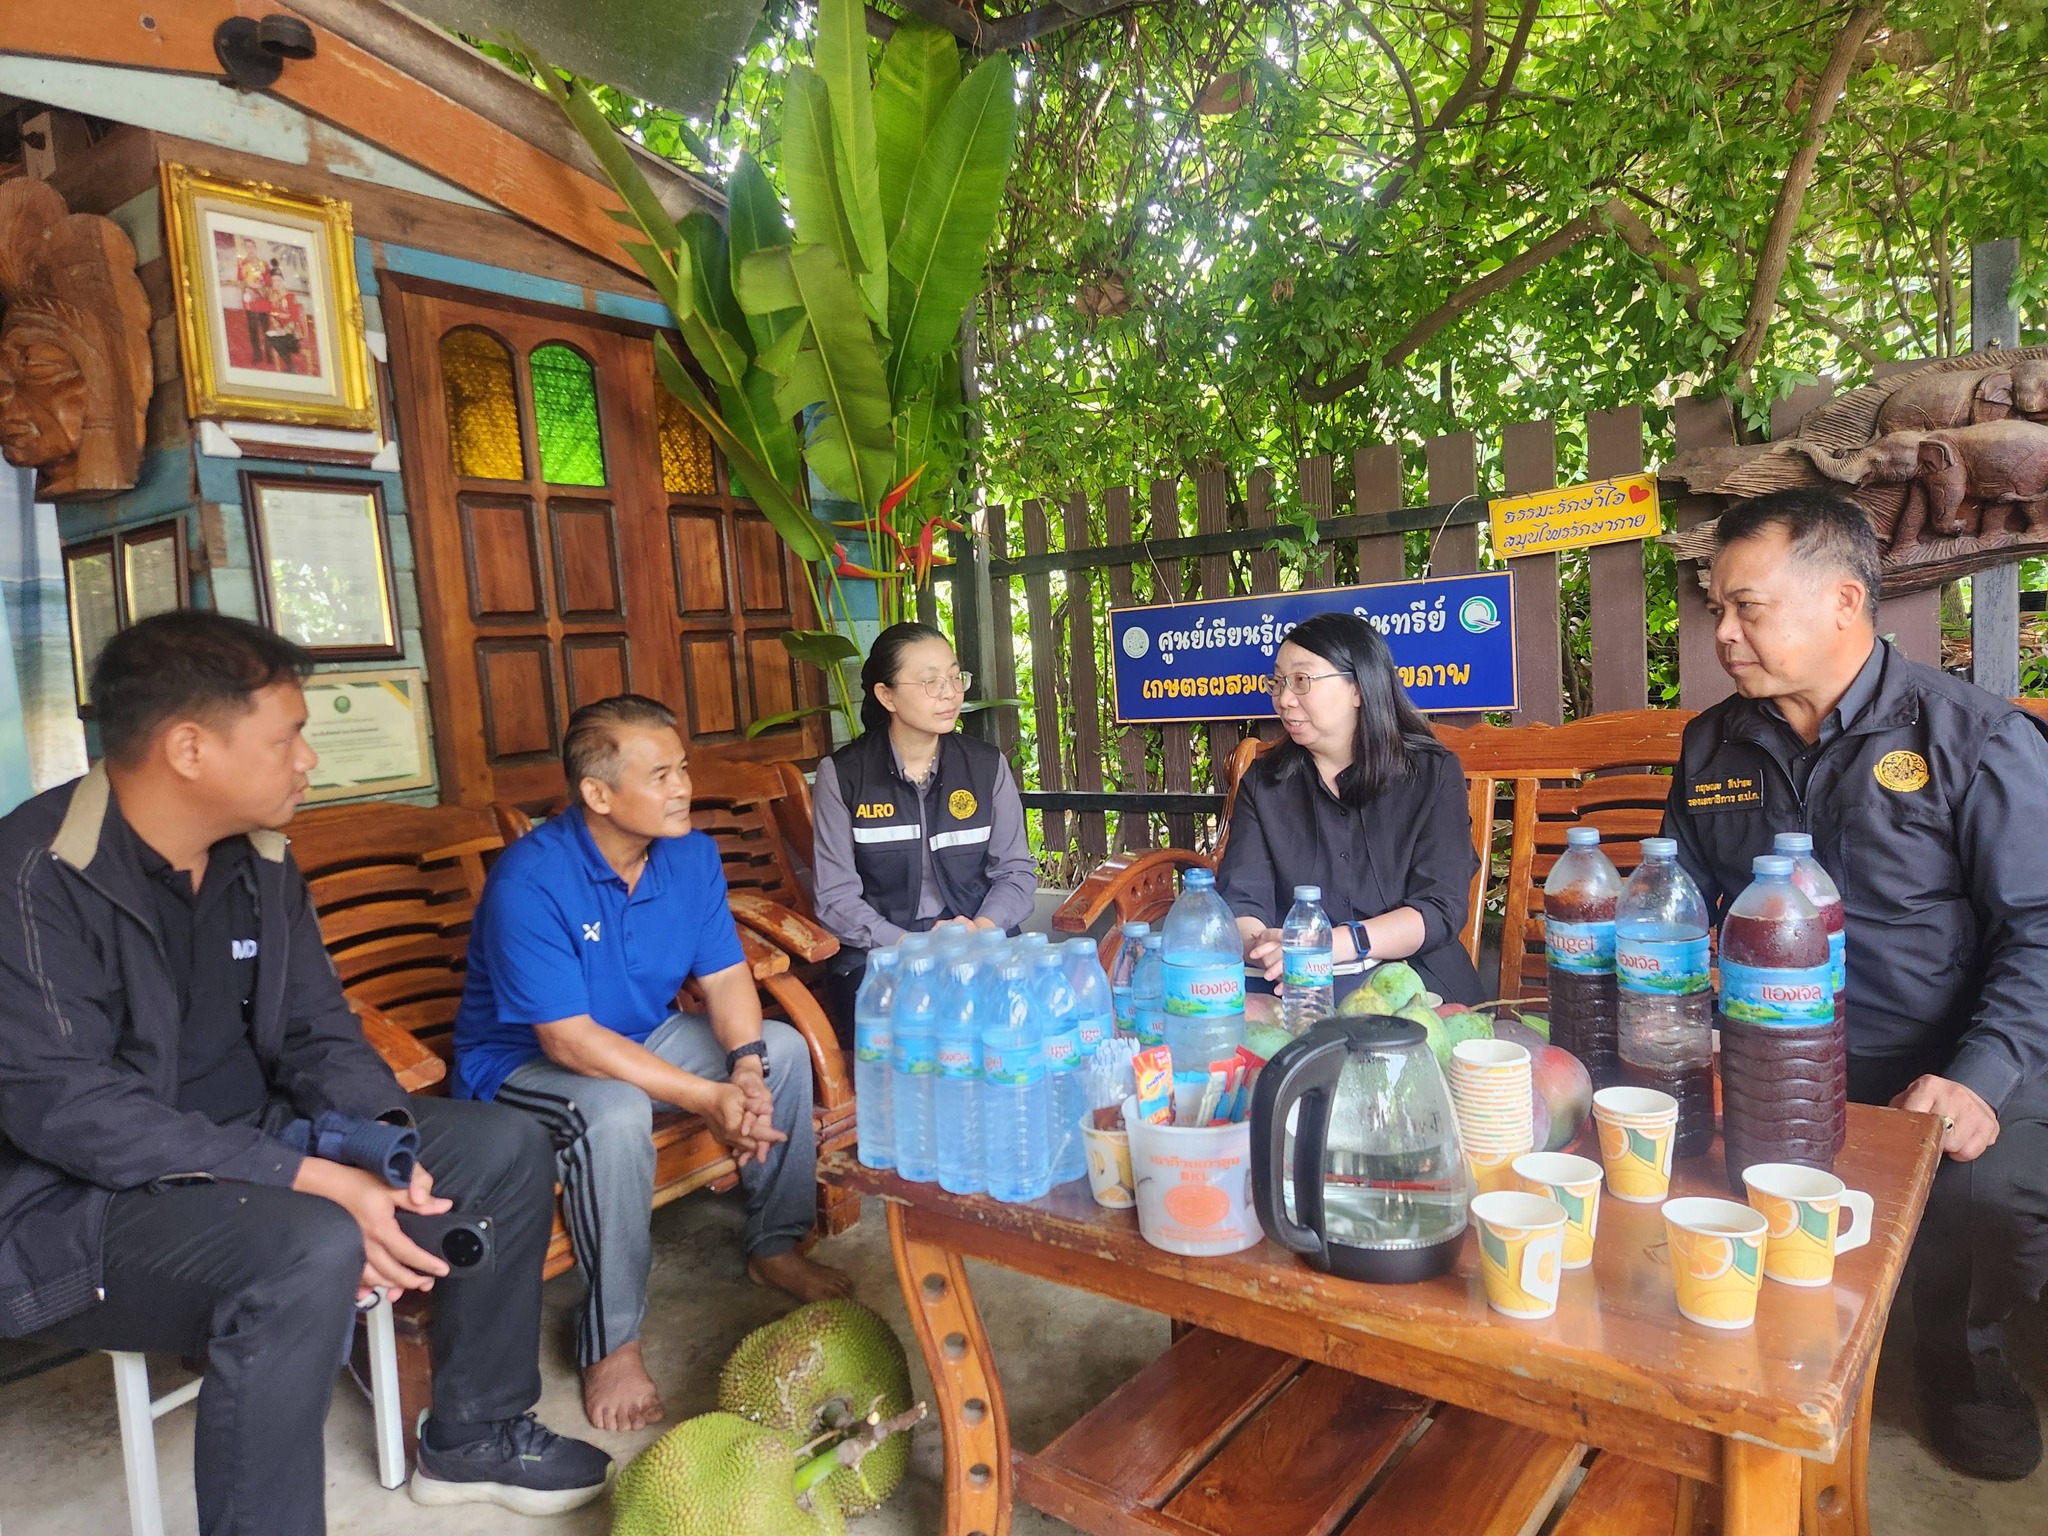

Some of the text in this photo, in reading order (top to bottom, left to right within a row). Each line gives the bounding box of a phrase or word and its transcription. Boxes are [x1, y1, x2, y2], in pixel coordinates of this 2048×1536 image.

[1504, 485, 1626, 524] ธรรมะรักษาใจ
[1503, 514, 1647, 552] สมุนไพรรักษากาย
[856, 803, 895, 819] ALRO
[1762, 984, 1823, 1002] แองเจิล
